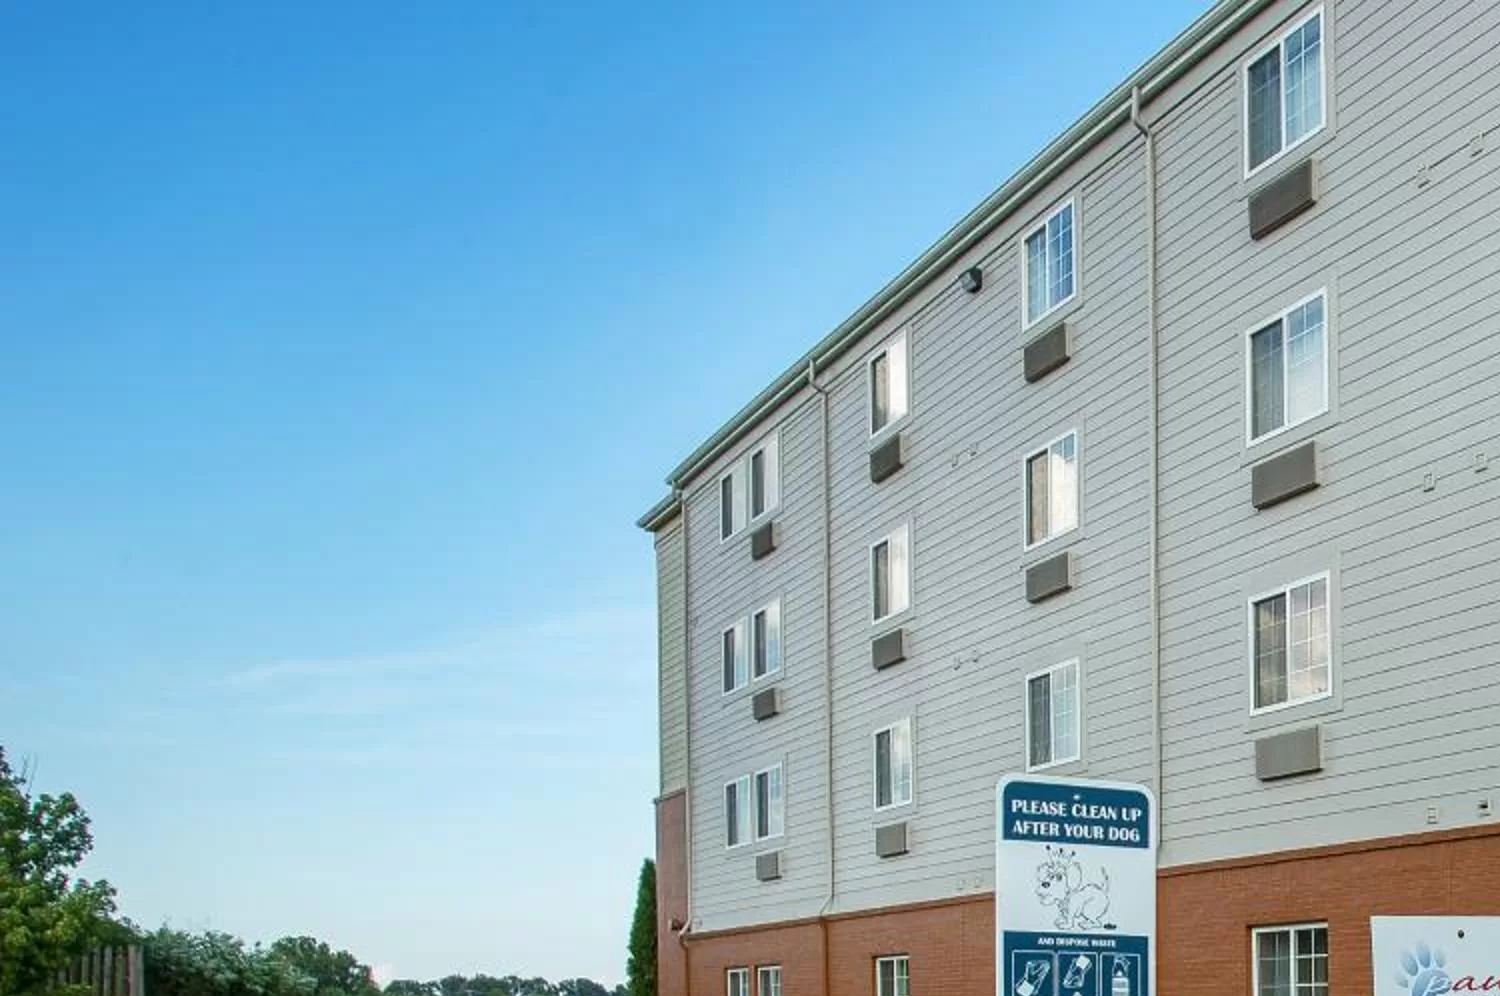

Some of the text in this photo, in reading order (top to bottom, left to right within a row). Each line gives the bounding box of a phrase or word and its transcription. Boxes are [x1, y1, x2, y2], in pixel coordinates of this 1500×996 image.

[1011, 799, 1142, 821] PLEASE CLEAN UP
[1013, 820, 1140, 842] AFTER YOUR DOG
